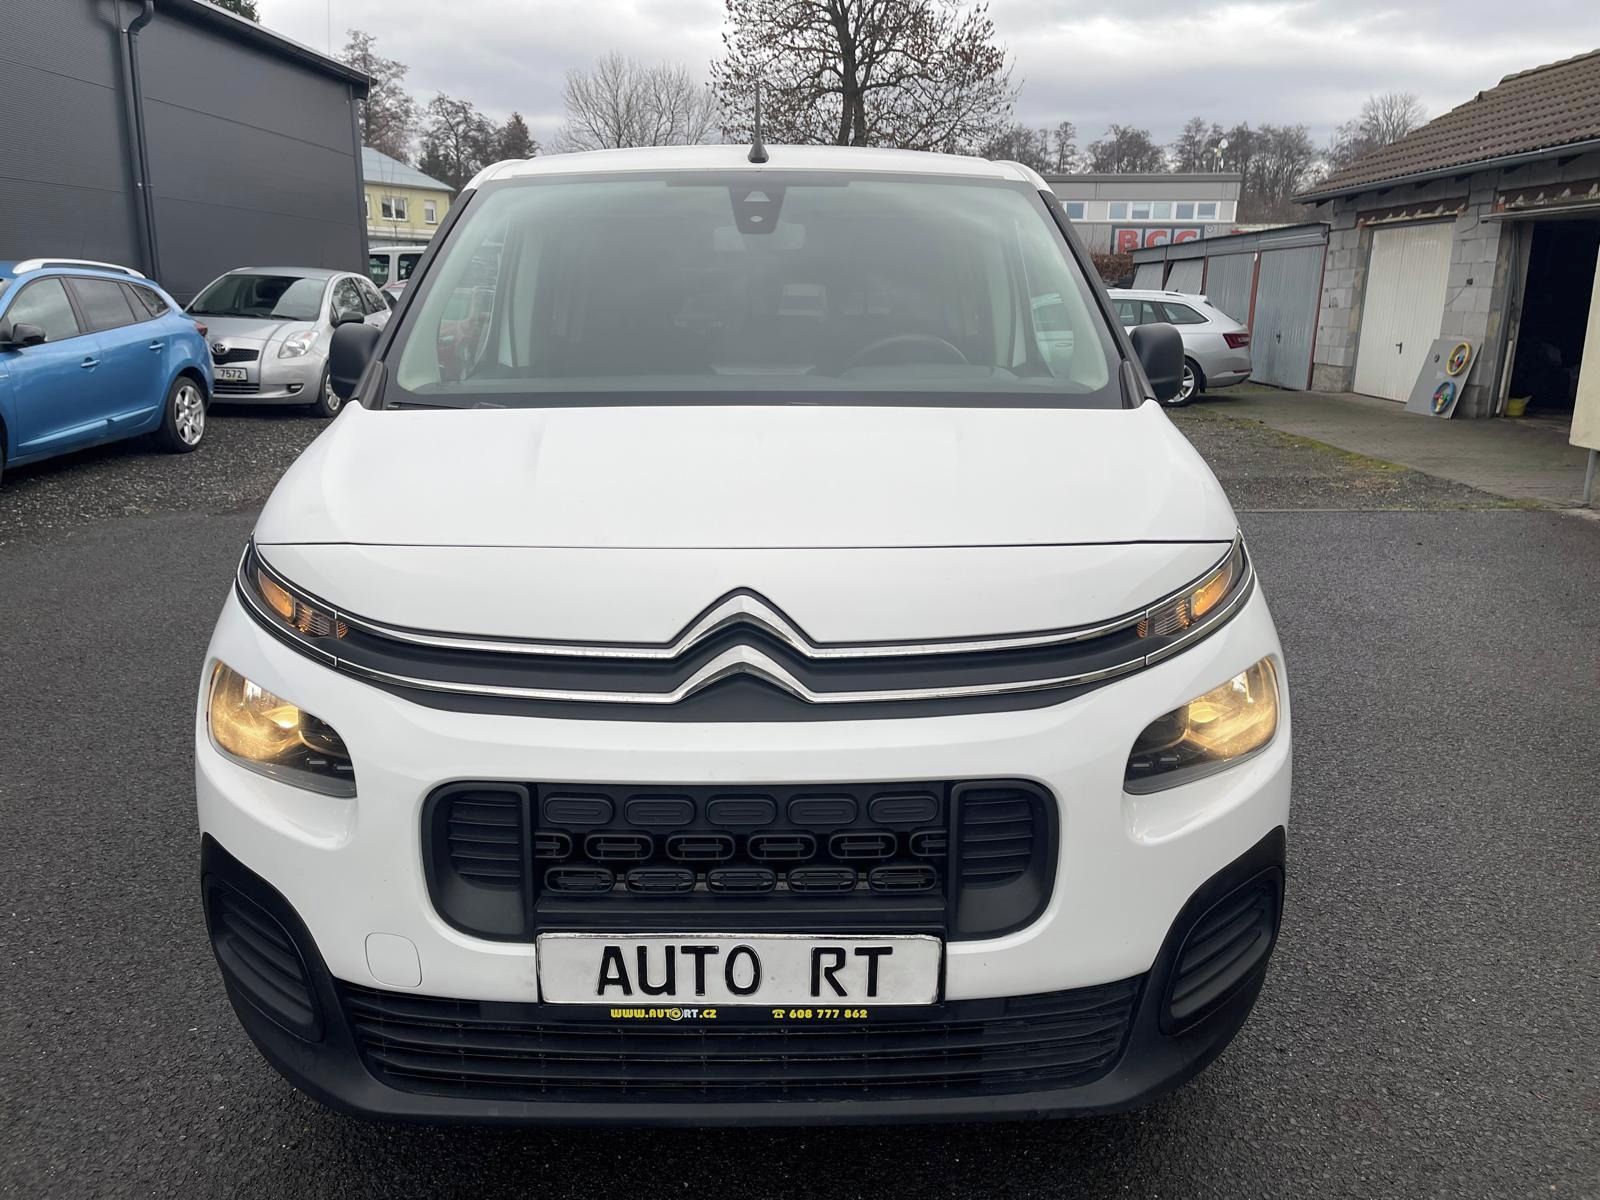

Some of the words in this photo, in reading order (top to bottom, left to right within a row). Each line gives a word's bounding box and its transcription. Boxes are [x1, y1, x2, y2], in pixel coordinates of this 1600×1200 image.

[220, 369, 243, 379] 7572
[596, 944, 763, 997] AUTO
[810, 946, 893, 997] RT
[789, 1009, 813, 1019] 608
[816, 1009, 840, 1019] 777
[844, 1009, 868, 1019] 862
